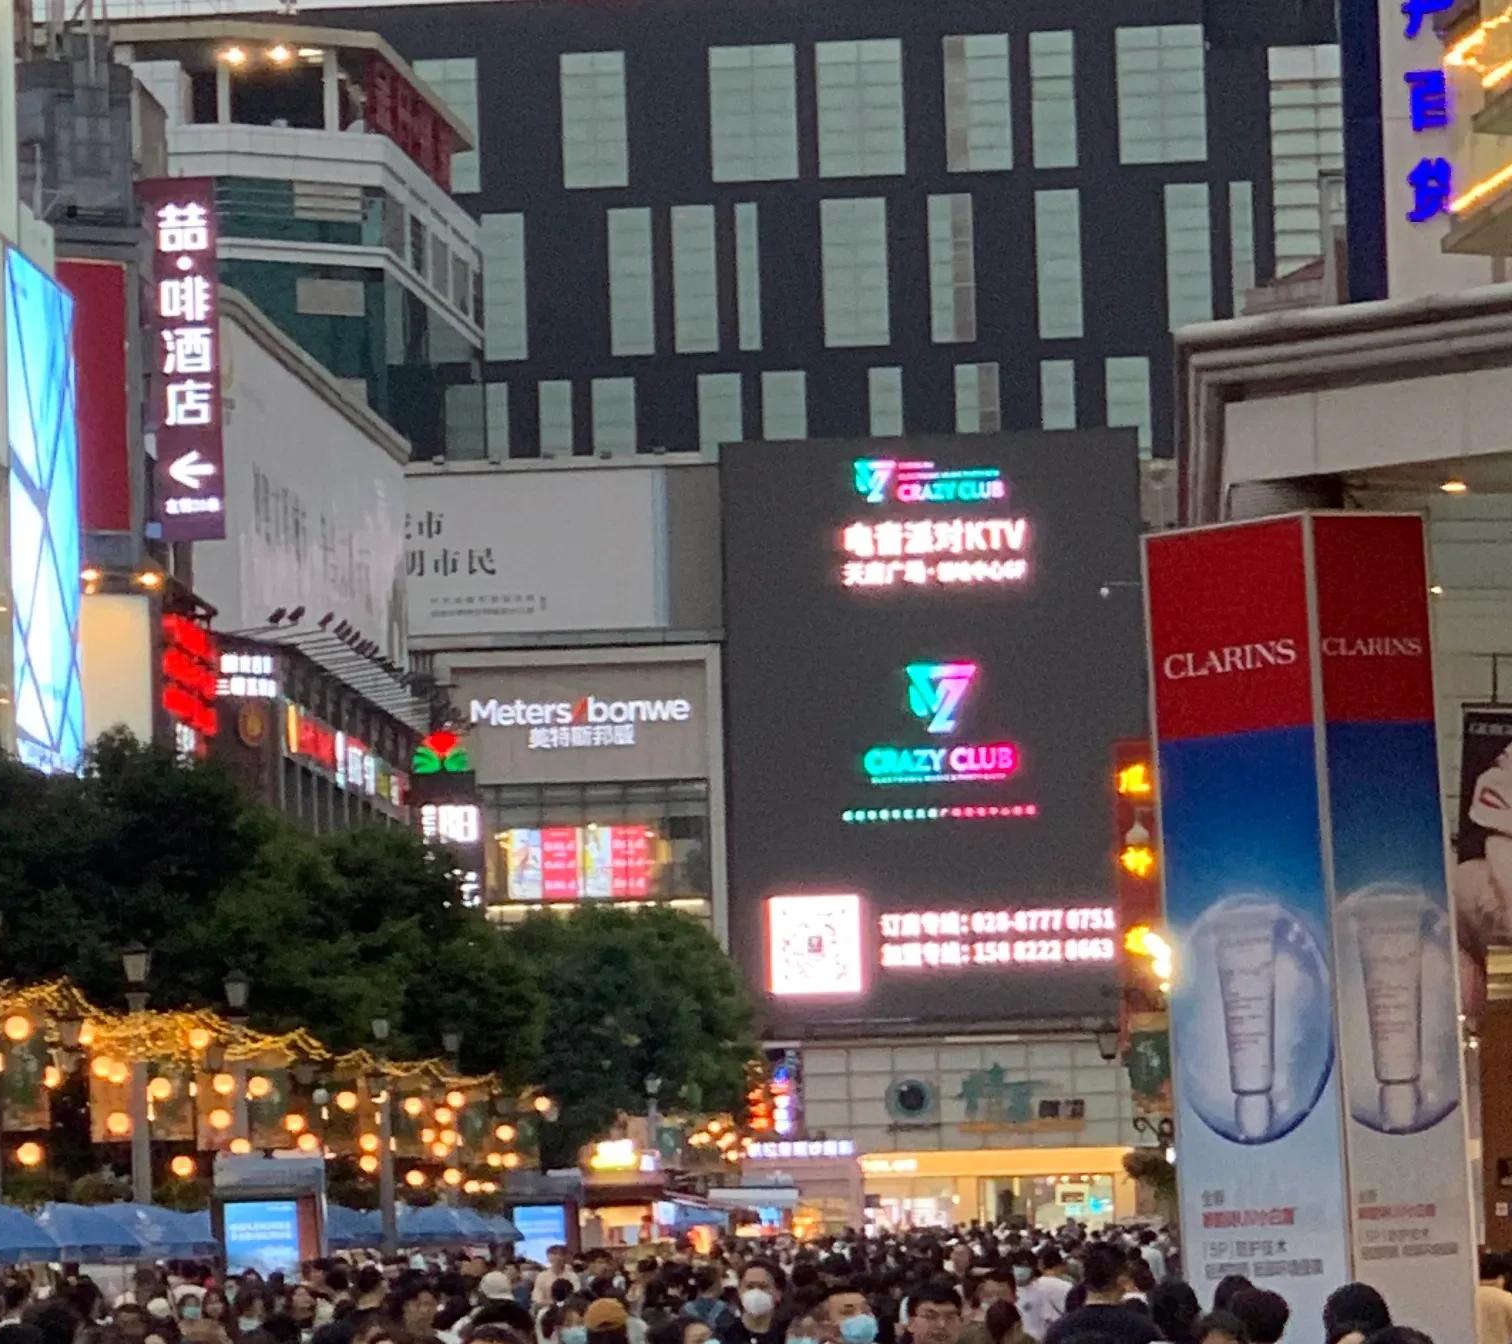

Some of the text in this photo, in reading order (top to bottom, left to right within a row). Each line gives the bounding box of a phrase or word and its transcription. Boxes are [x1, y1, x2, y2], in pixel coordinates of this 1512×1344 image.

[897, 478, 1006, 502] CRAZY CLUB
[1163, 638, 1297, 680] CLARINS
[1322, 636, 1423, 657] CLARINS
[863, 744, 1015, 776] CRAZY CLUB
